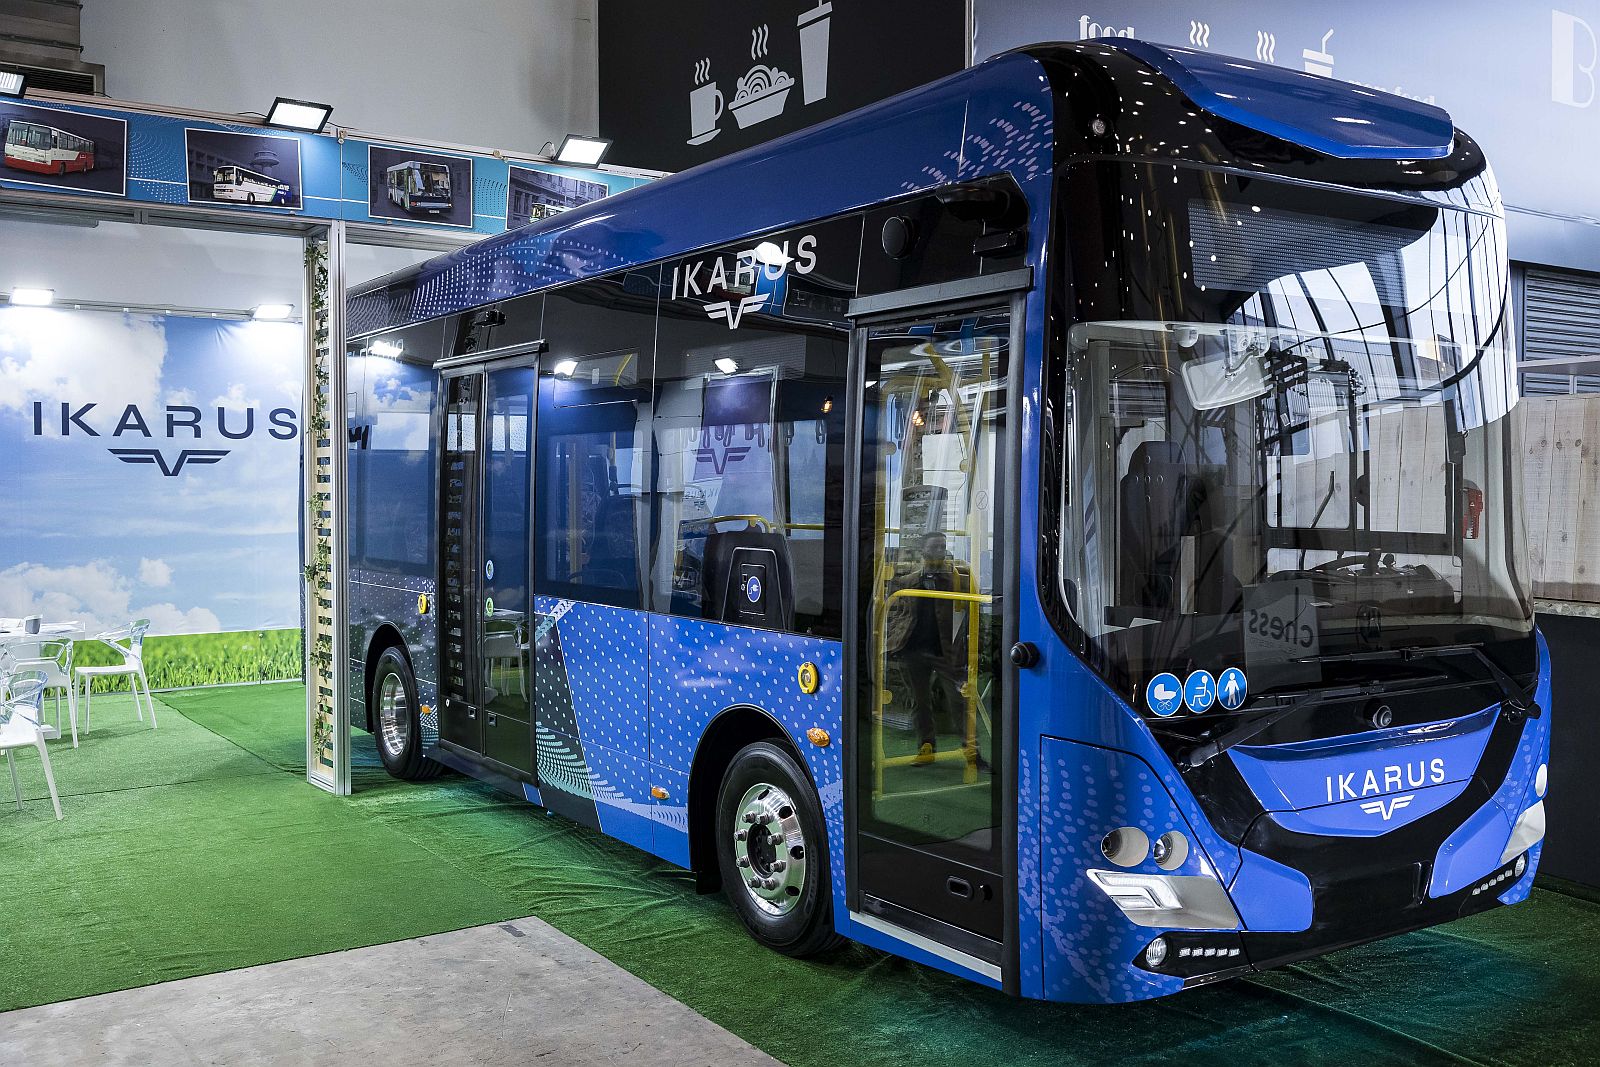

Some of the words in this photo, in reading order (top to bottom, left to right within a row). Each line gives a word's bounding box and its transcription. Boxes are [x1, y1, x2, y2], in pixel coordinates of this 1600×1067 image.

[671, 234, 817, 301] IKARUS
[33, 401, 298, 440] IKARUS
[1326, 758, 1445, 802] IKARUS
